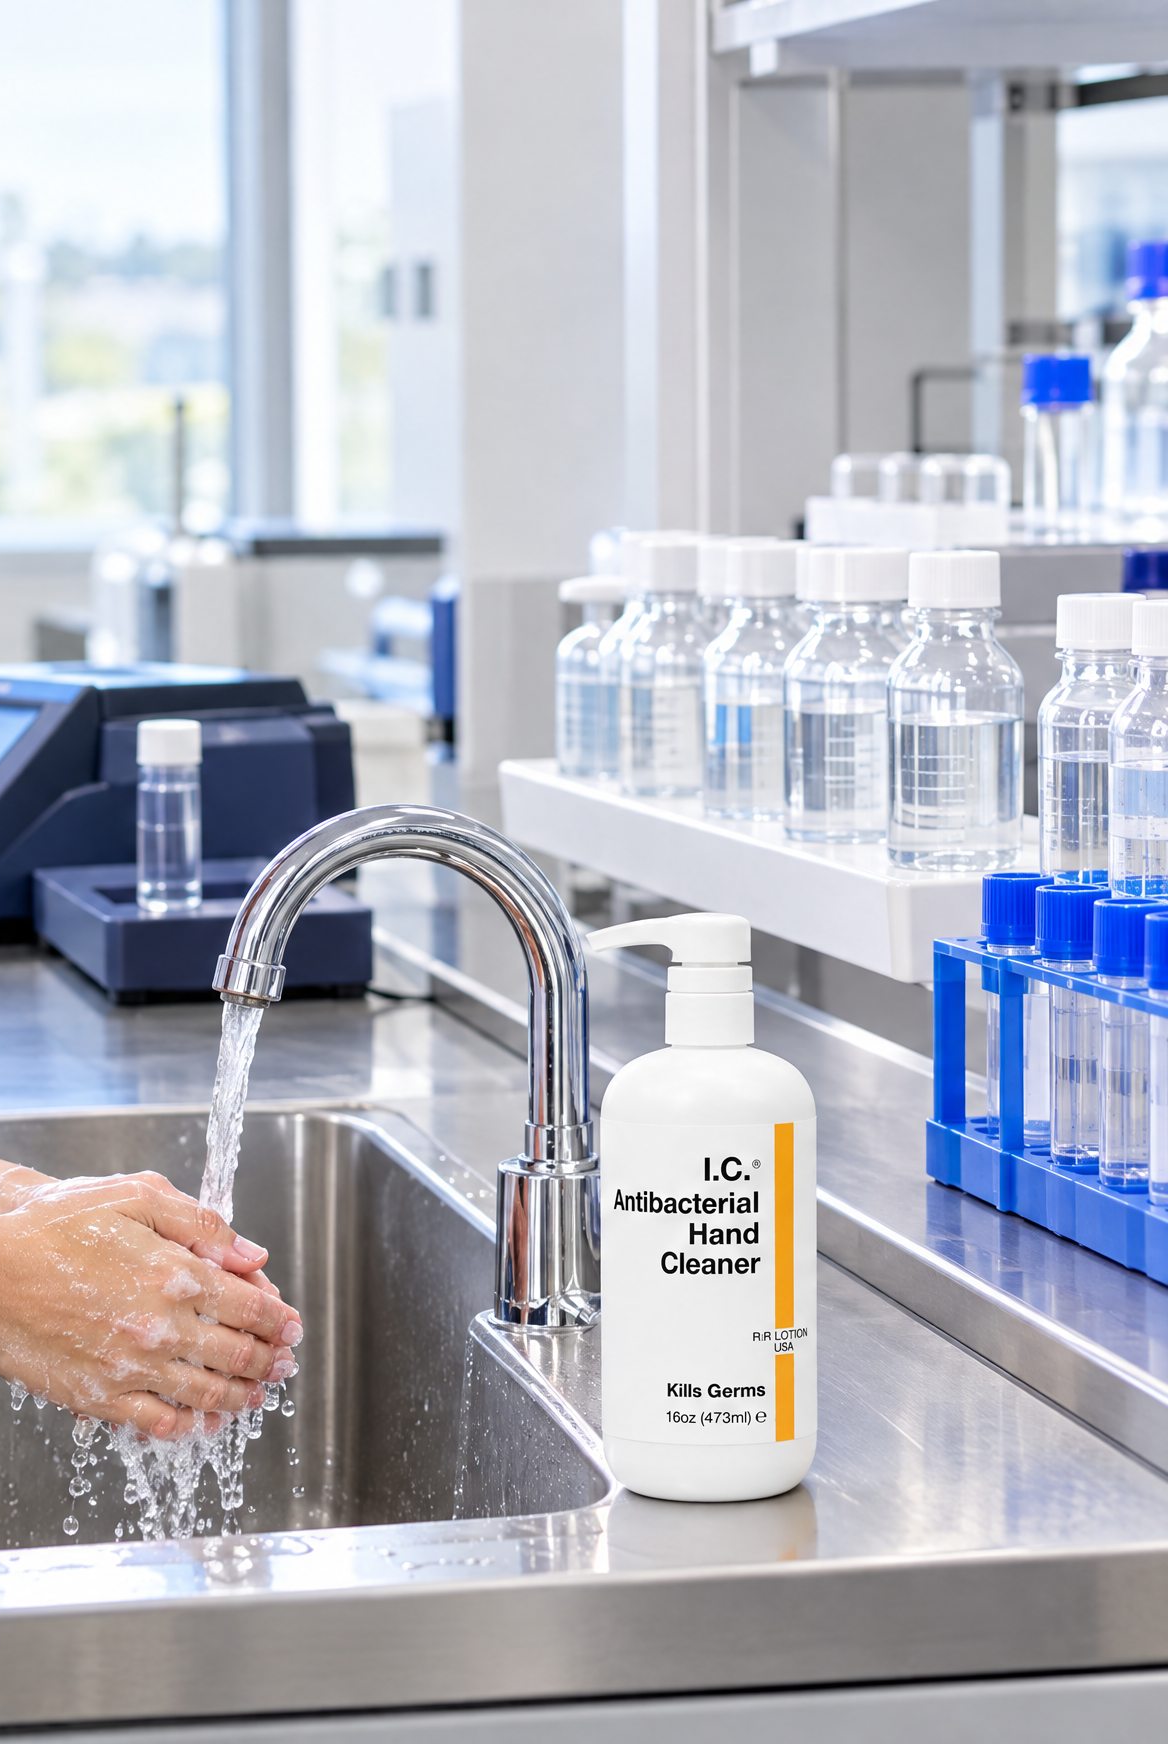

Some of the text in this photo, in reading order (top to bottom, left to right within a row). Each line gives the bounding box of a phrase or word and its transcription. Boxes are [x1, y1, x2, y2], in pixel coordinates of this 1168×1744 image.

[613, 1188, 759, 1215] Antibacterial
[689, 1221, 760, 1246] Hand
[660, 1250, 762, 1275] Cleaner
[774, 1327, 808, 1341] LOTION
[774, 1341, 794, 1353] USA
[667, 1382, 766, 1398] Kills Germs
[666, 1410, 697, 1424] 16oz
[700, 1410, 752, 1427] (473ml)
